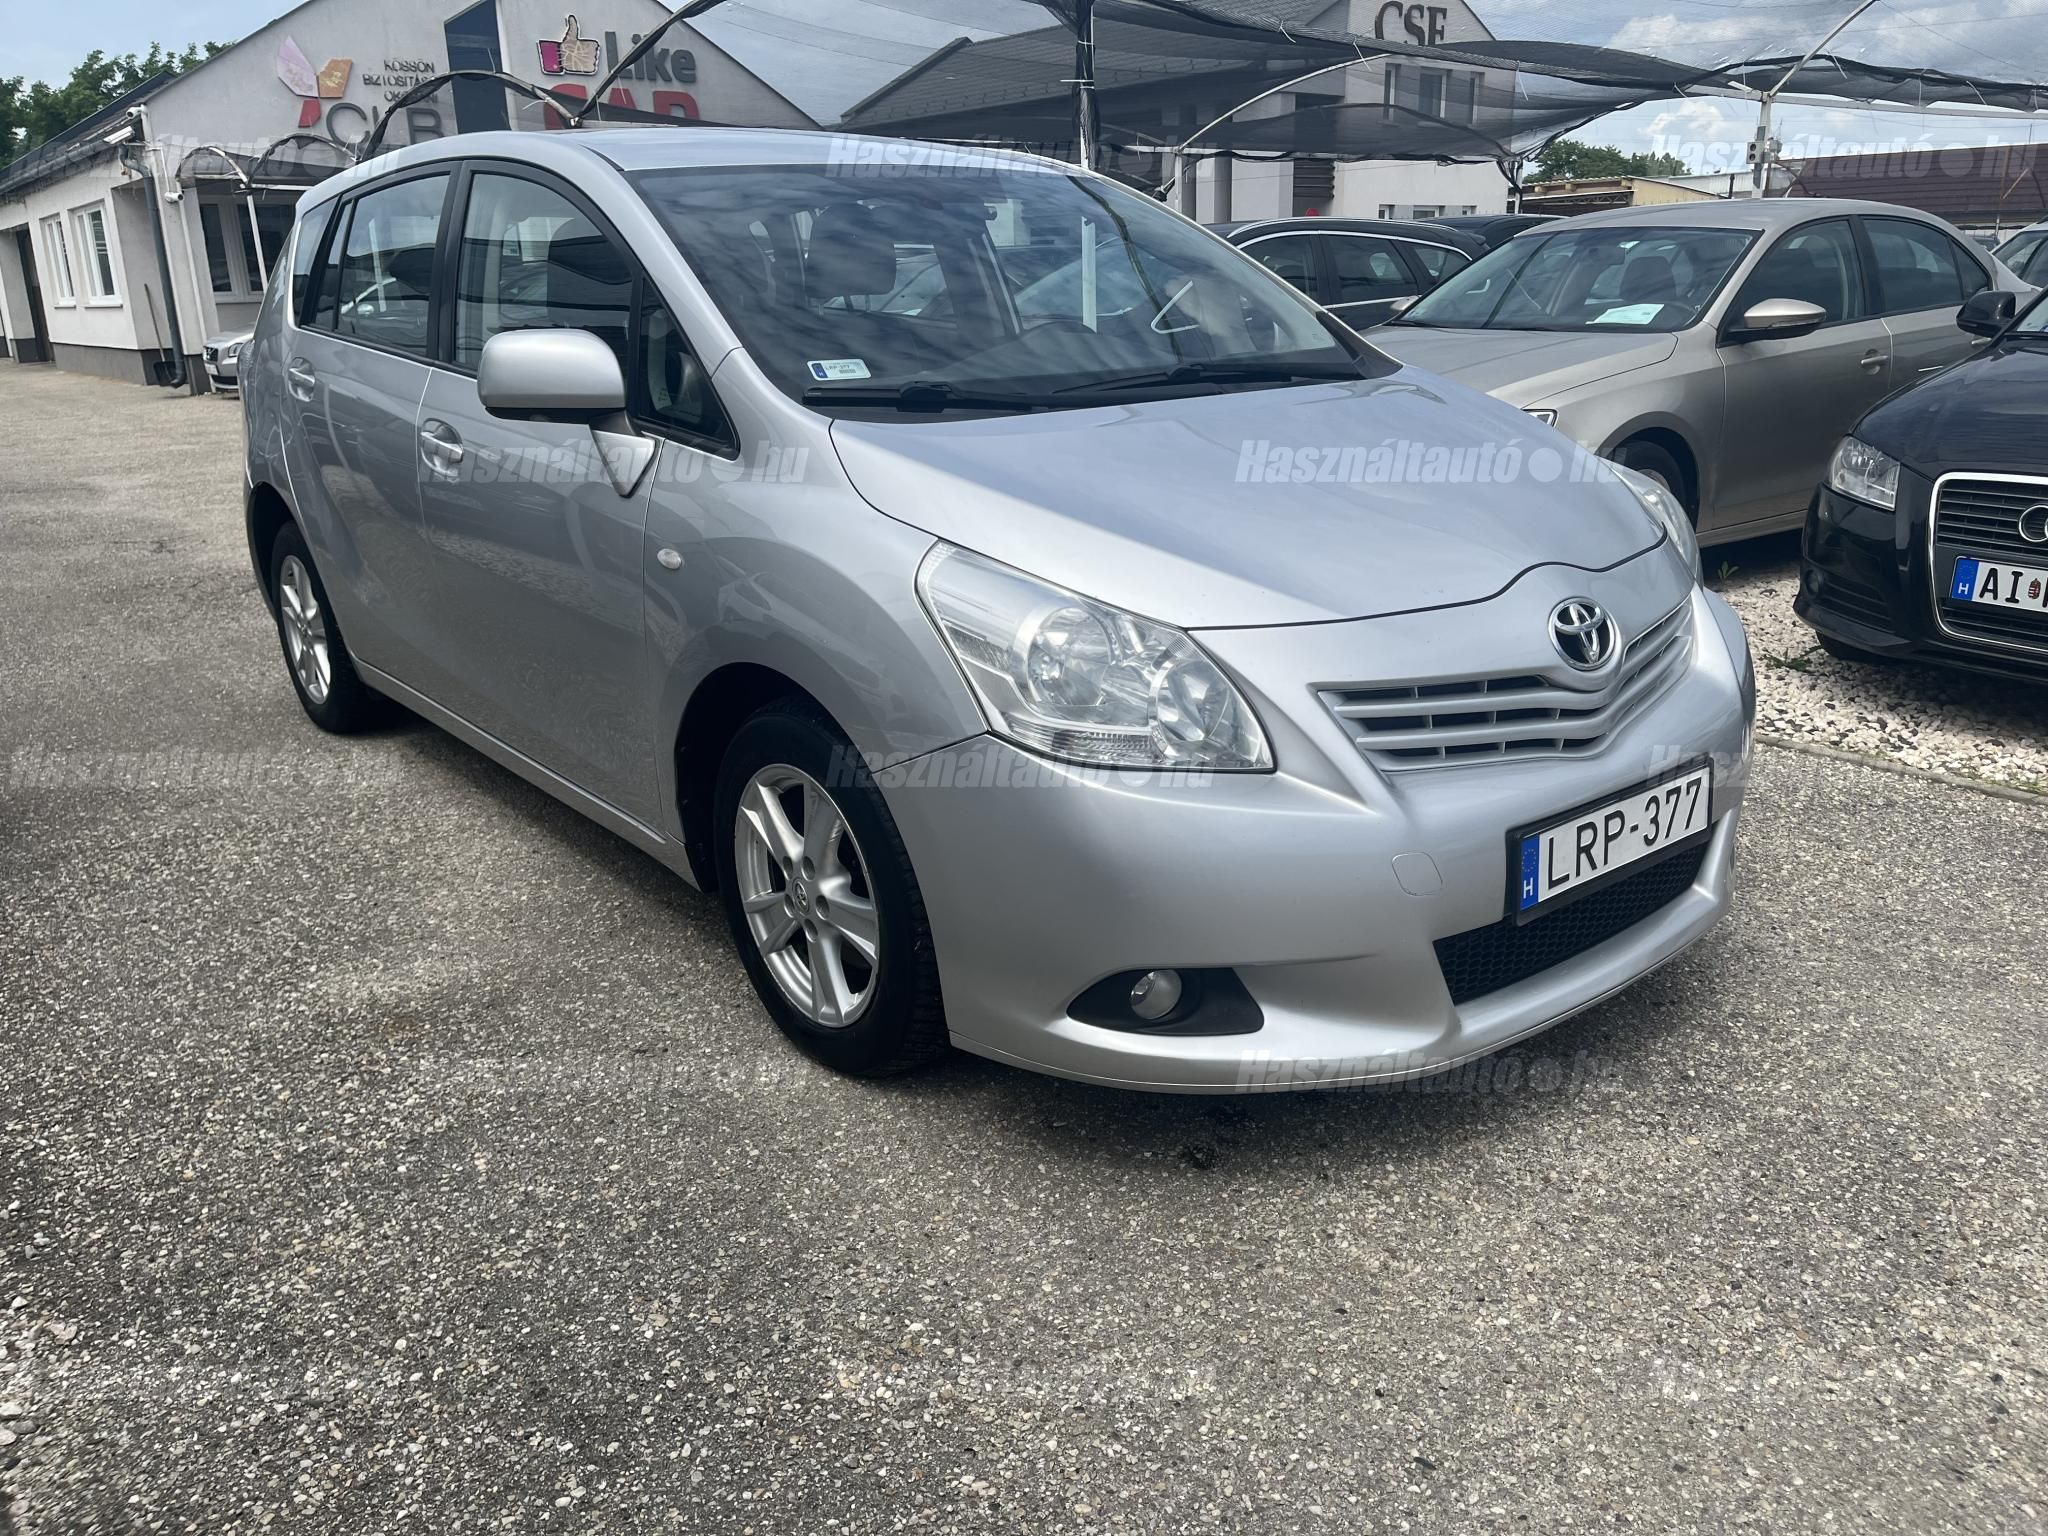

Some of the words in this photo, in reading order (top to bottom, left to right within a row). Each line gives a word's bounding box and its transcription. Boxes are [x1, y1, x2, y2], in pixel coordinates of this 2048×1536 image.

[1374, 0, 1448, 46] CSE
[604, 31, 697, 83] Like
[1547, 776, 1702, 891] LRP-377
